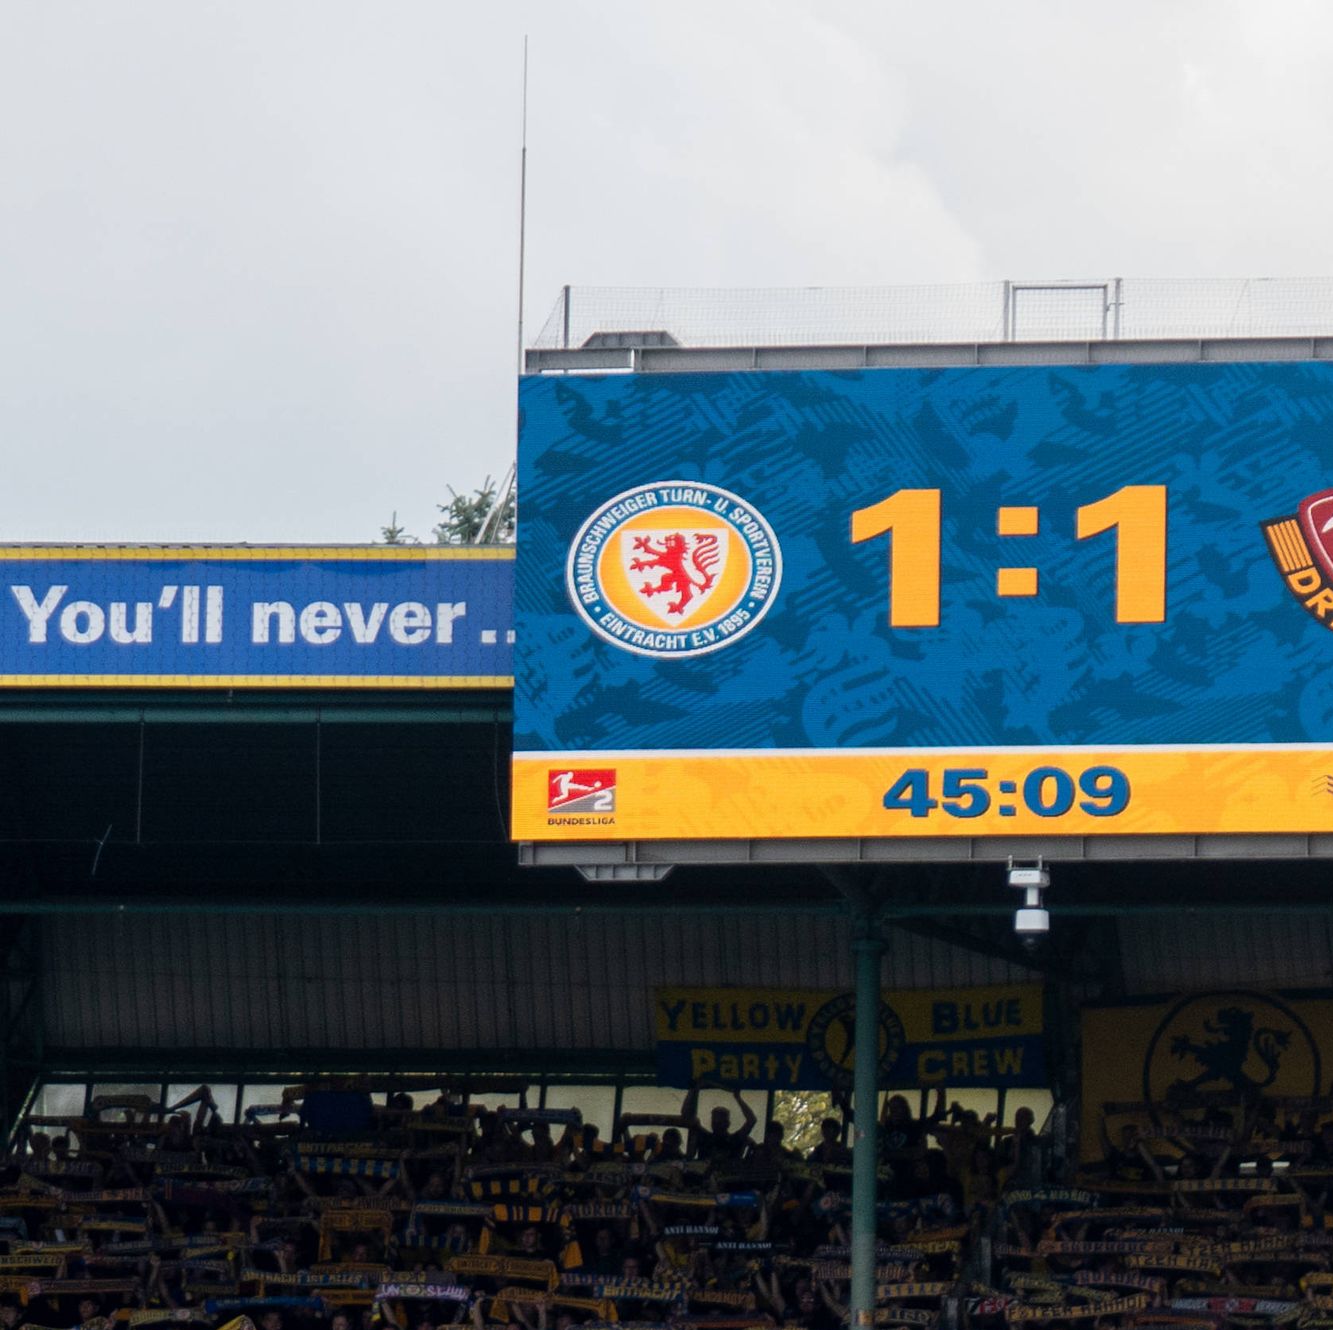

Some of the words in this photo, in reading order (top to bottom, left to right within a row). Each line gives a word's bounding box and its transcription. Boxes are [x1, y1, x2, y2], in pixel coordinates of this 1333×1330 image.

[576, 490, 658, 605] BRAUNSCHWEIGER
[659, 488, 712, 506] TURN-
[714, 500, 728, 515] U.
[729, 507, 773, 601] SPORTVEREIN
[850, 487, 942, 628] 1
[1076, 484, 1168, 624] 1
[10, 584, 224, 645] You'll
[599, 613, 687, 650] EINTRACHT
[691, 628, 719, 648] E.V.
[718, 609, 751, 634] 1895
[593, 787, 615, 813] 2
[882, 766, 1132, 819] 45:09
[547, 816, 616, 827] BUNDESLIGA
[661, 1000, 806, 1033] YELLOW
[930, 999, 1021, 1035] BLUE
[916, 1047, 1024, 1081] CREW
